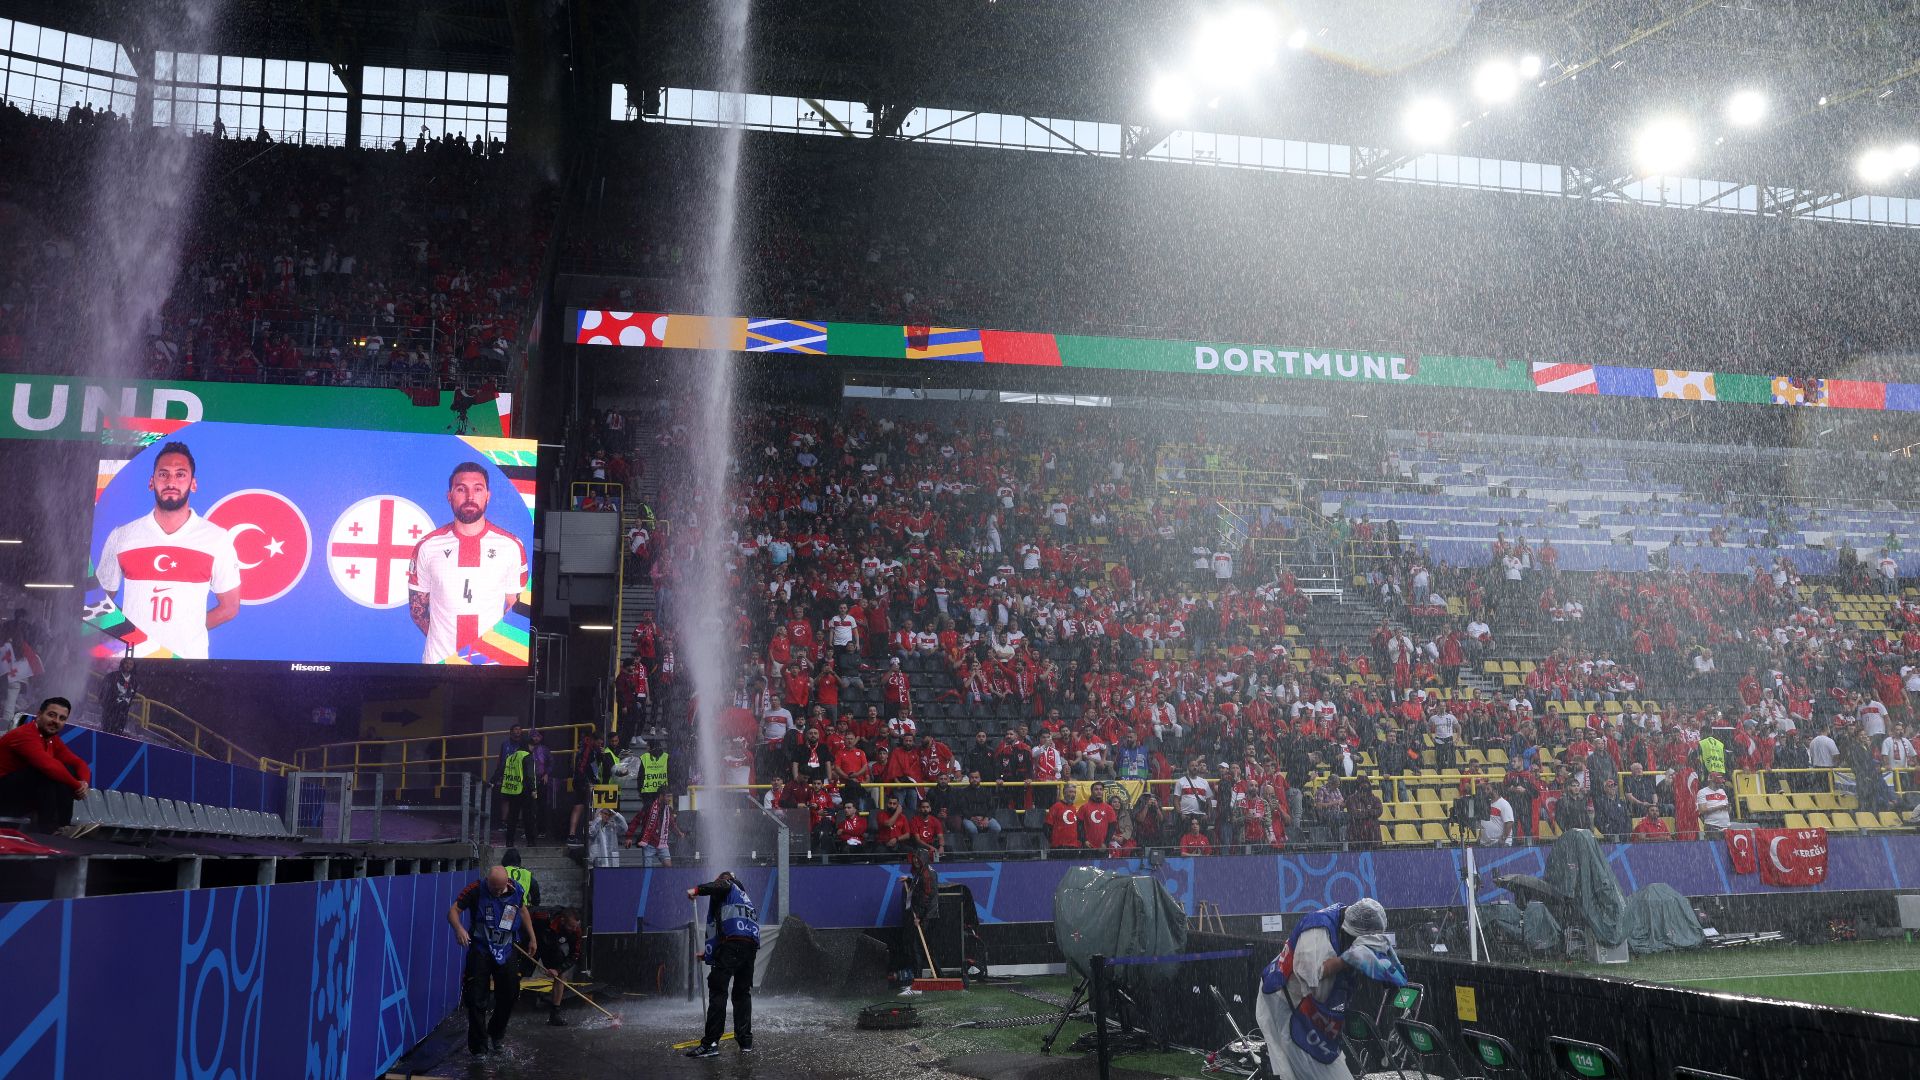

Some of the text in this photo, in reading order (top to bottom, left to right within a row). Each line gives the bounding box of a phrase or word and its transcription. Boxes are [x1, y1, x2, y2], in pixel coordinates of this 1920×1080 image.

[1195, 346, 1411, 380] DORTMUND
[463, 579, 472, 604] 4
[150, 596, 173, 622] 10
[290, 663, 331, 672] Hisense
[1743, 777, 1750, 787] 7
[1797, 829, 1818, 839] KDZ
[1413, 1031, 1425, 1043] 116
[1482, 1044, 1494, 1056] 115
[1575, 1054, 1593, 1067] 114
